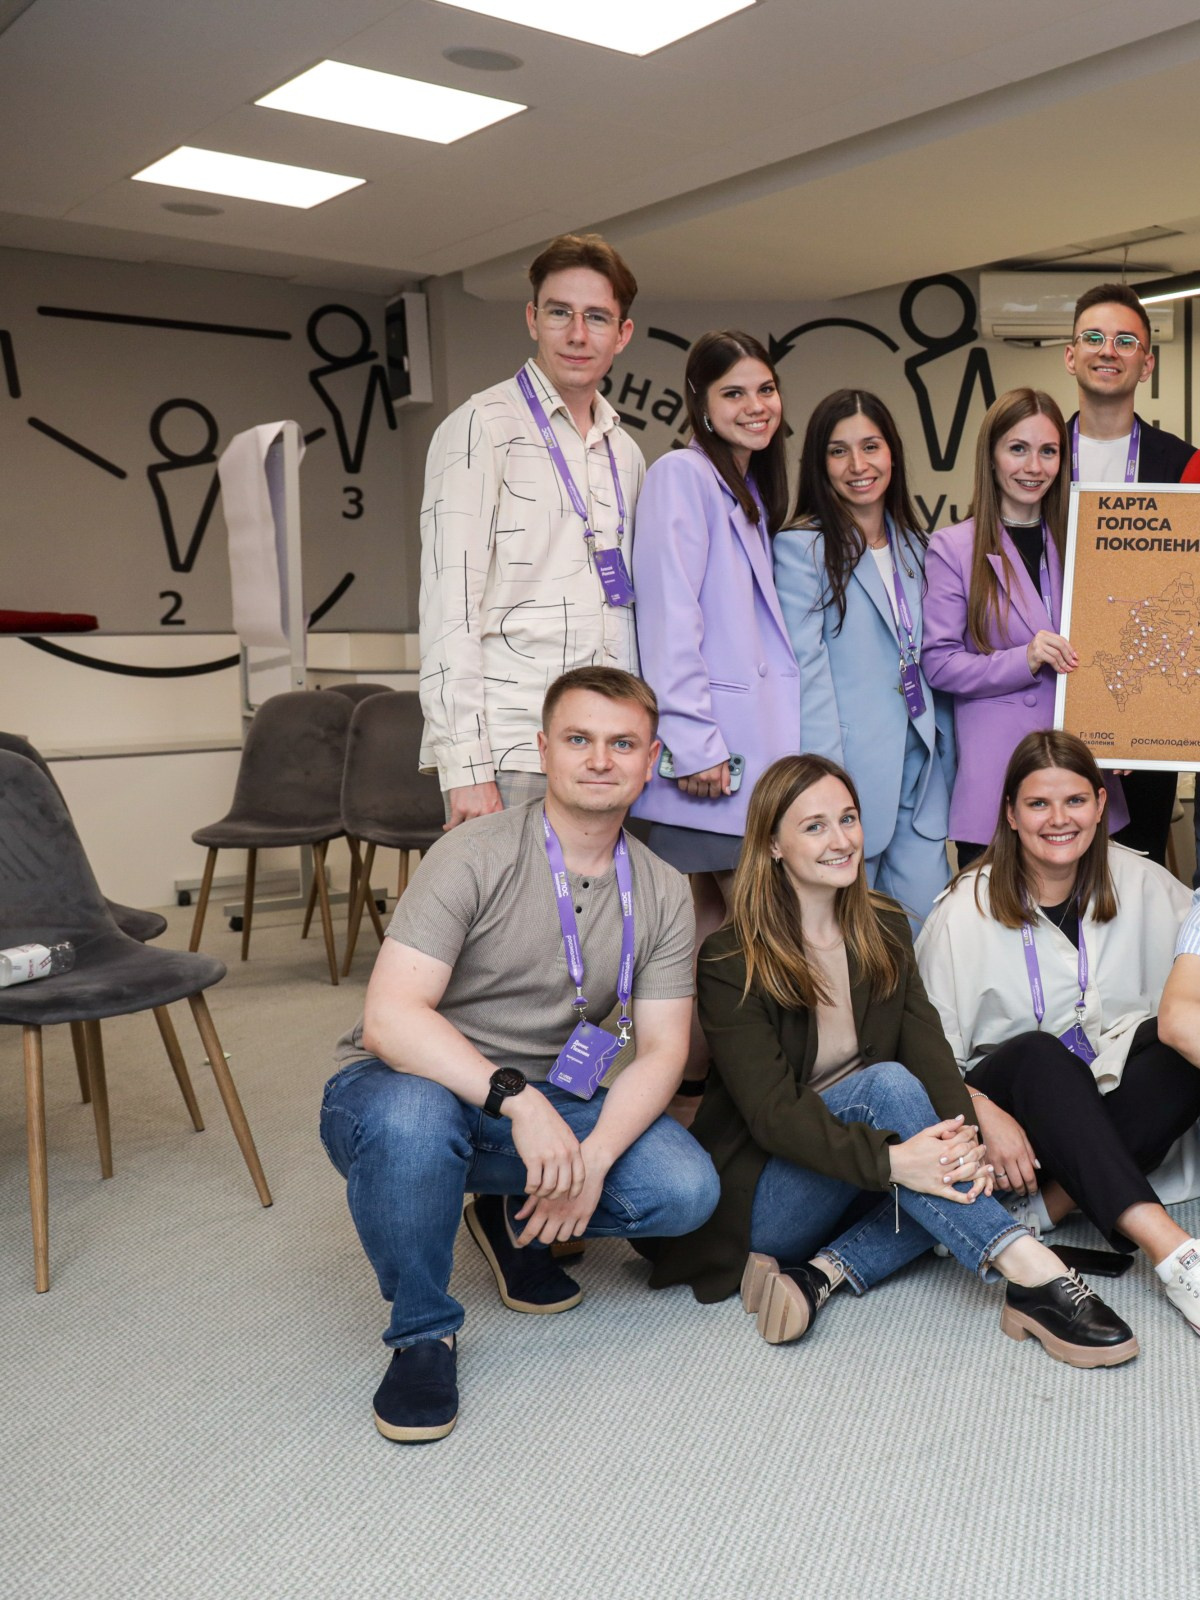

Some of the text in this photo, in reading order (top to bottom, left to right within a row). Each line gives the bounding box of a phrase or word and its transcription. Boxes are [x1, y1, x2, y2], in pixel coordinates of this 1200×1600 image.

[341, 486, 365, 520] 3
[1098, 496, 1158, 511] КАРТА
[1096, 516, 1172, 532] ГОЛОСА
[159, 590, 186, 626] 2
